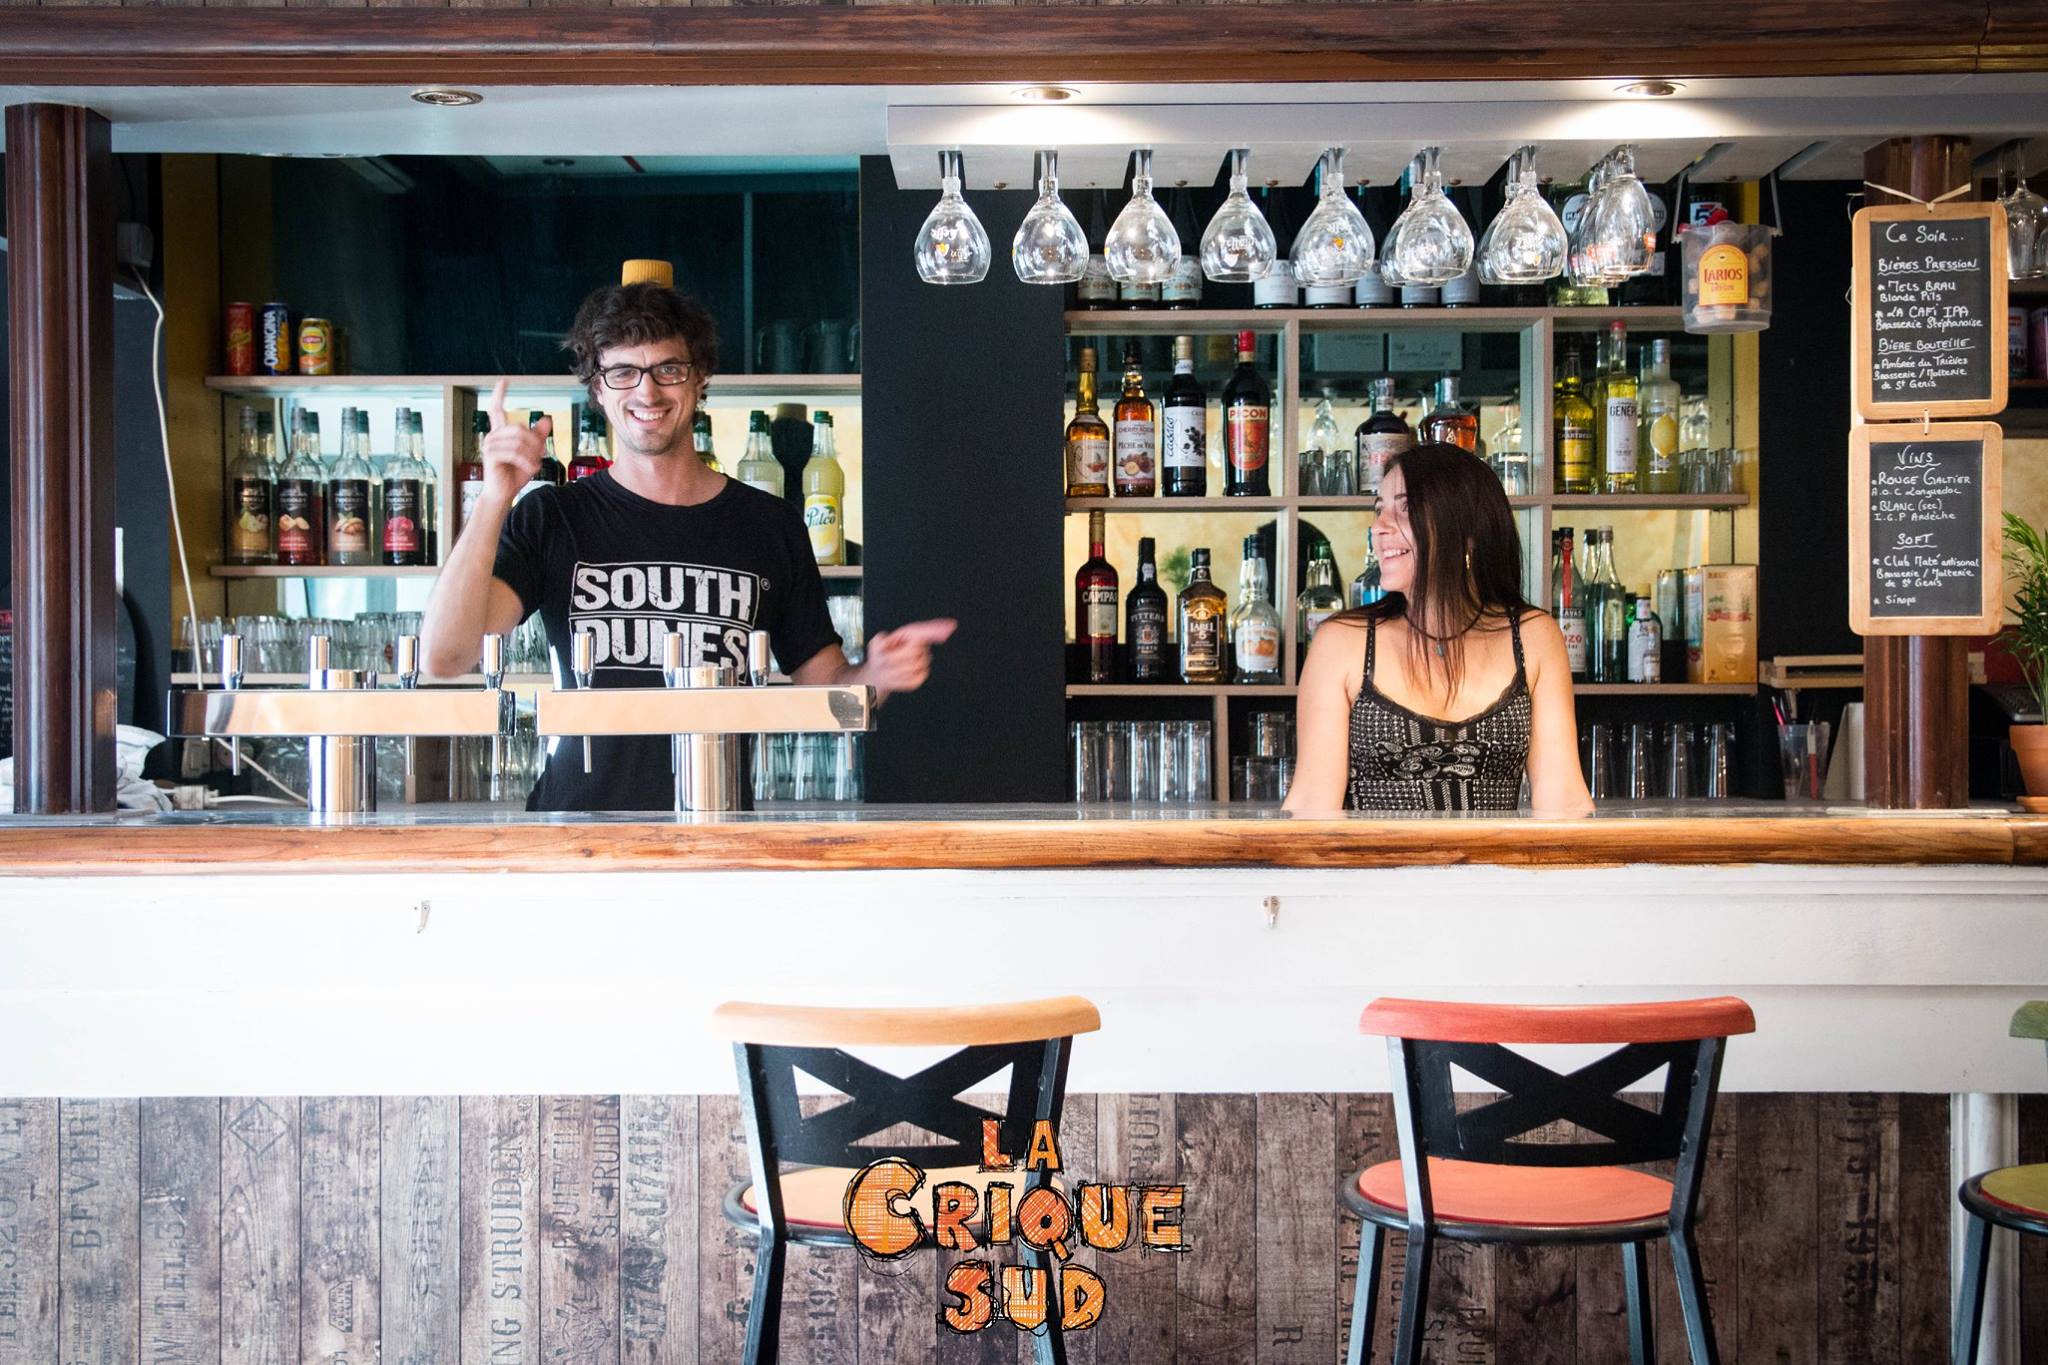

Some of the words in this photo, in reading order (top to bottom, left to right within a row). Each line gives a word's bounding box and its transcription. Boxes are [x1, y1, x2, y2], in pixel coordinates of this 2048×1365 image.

[1704, 269, 1743, 283] LARIOS
[1880, 292, 1916, 302] Blonde
[1921, 290, 1942, 302] Pils
[1943, 306, 1969, 317] IPA
[1918, 357, 1932, 367] du
[1879, 500, 1914, 512] BLANC
[1896, 533, 1934, 545] SOFT
[1883, 555, 1910, 567] Club
[573, 566, 753, 622] SOUTH
